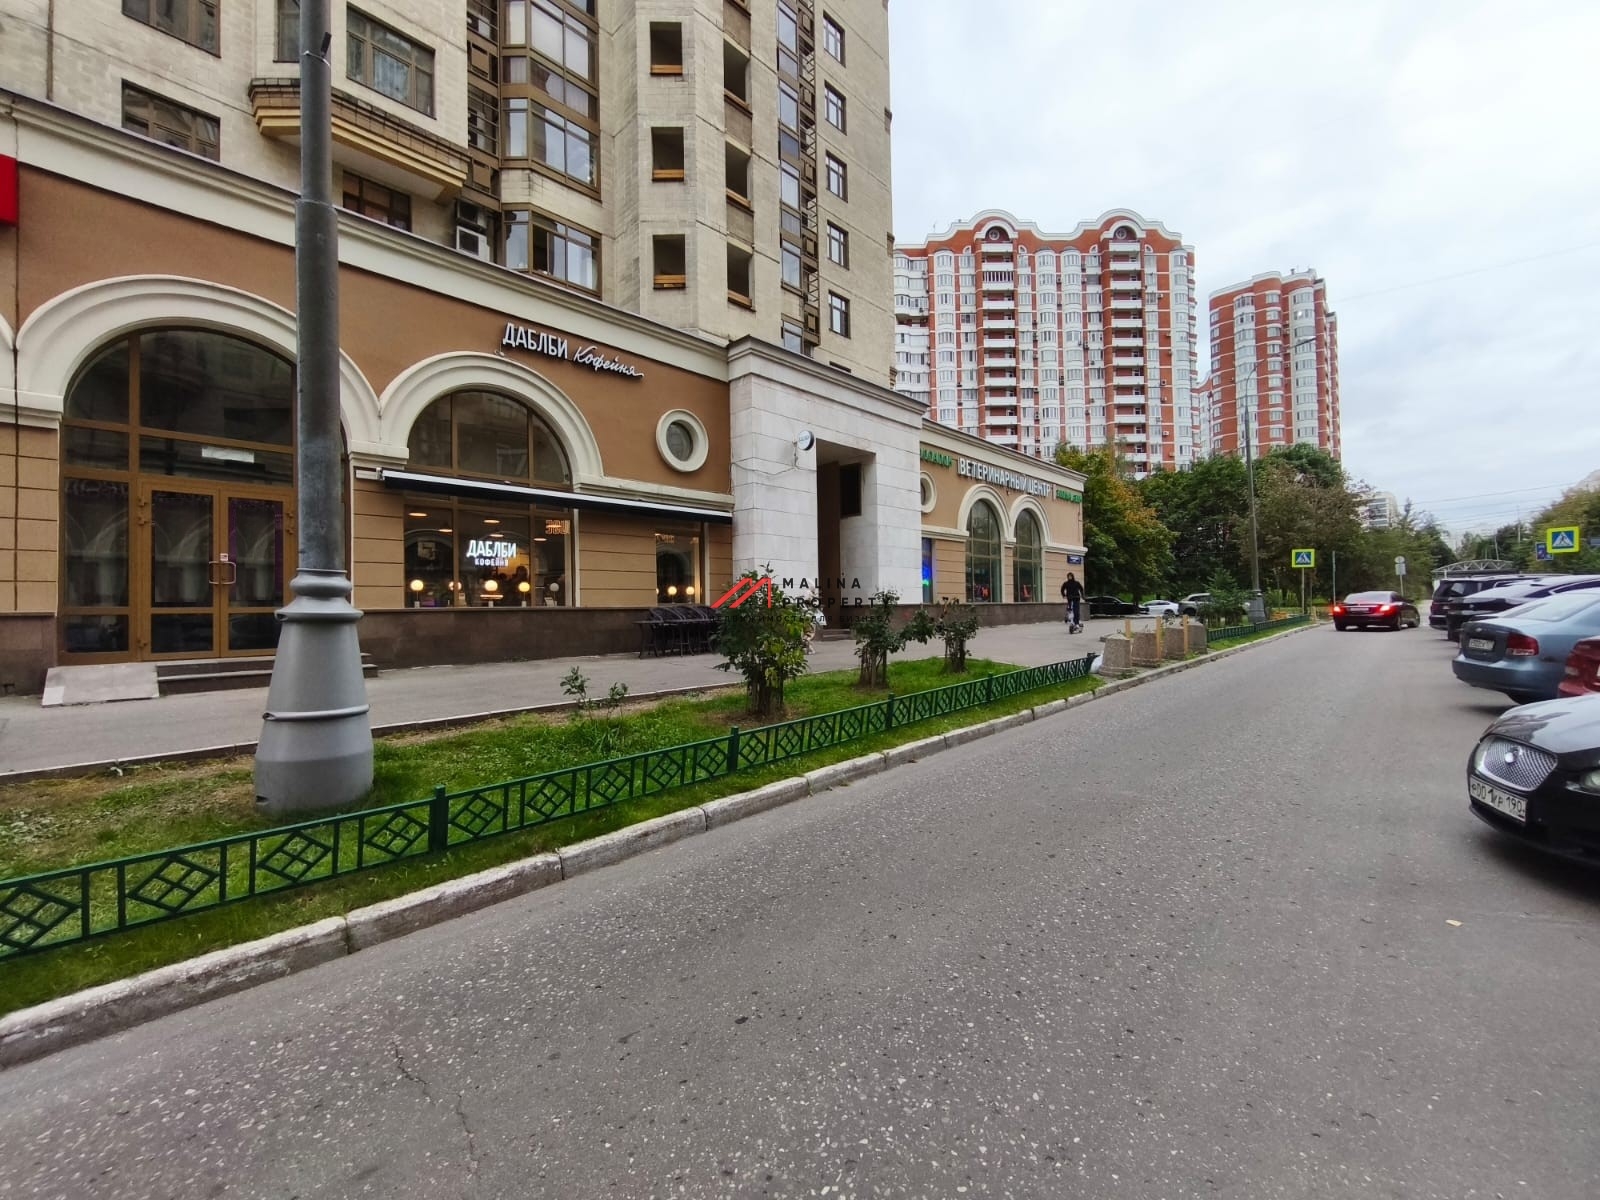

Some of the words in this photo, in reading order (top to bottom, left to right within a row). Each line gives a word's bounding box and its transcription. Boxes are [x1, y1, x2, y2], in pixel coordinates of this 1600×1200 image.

[502, 322, 568, 359] ДАБЛБИ
[573, 345, 645, 378] Кофейня
[958, 457, 1027, 491] ВЕТЕРИНАРНЫЙ
[1028, 478, 1050, 497] ЦЕНТР
[466, 539, 517, 559] ДАБЛБИ
